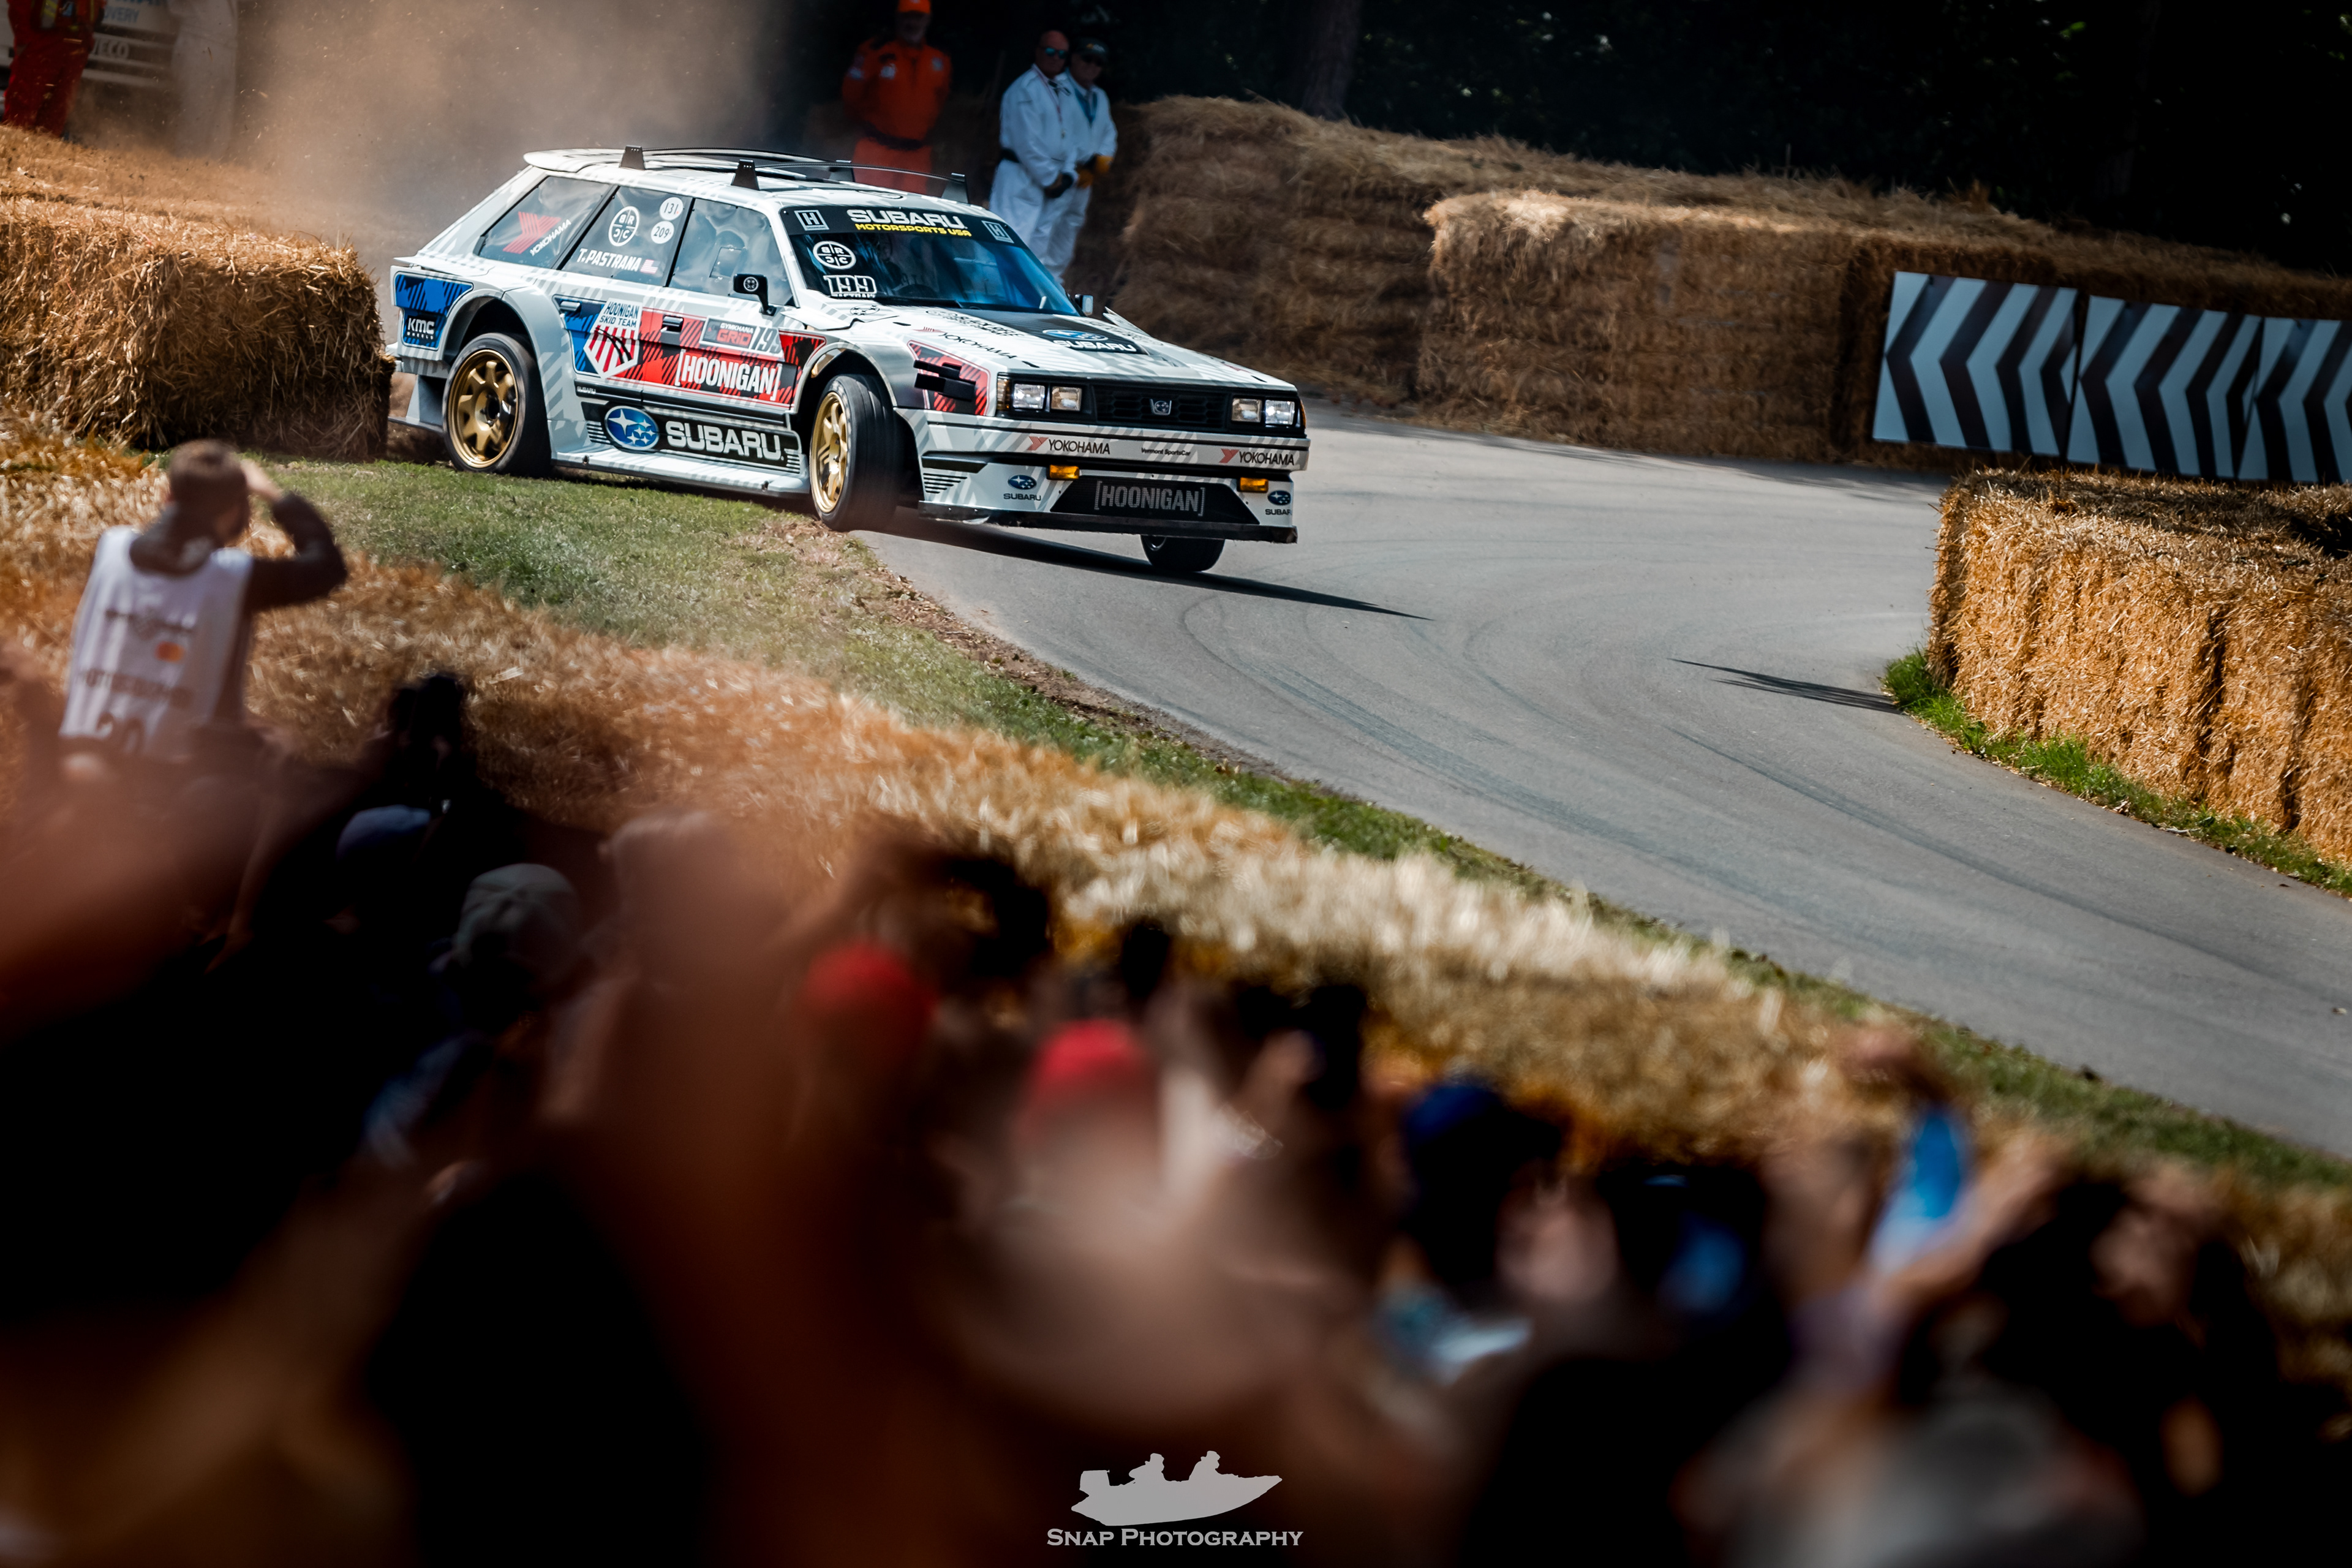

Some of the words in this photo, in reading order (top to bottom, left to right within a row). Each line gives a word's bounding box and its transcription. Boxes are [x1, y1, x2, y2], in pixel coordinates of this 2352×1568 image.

[530, 219, 571, 256] YOKOHAMA
[855, 224, 946, 235] MOTORSPORTS
[948, 228, 971, 237] USA
[823, 275, 877, 294] 199
[604, 301, 639, 318] HOONIGAN
[600, 315, 616, 325] SKID
[618, 318, 637, 328] TEAM
[720, 323, 754, 334] GYMKHANA
[938, 333, 1018, 359] YOKOHAMA
[1053, 339, 1137, 352] SUBARU
[1049, 438, 1110, 454] YOKOHAMA
[1239, 451, 1295, 466] YOKOHAMA
[1003, 492, 1041, 502] SUBARU
